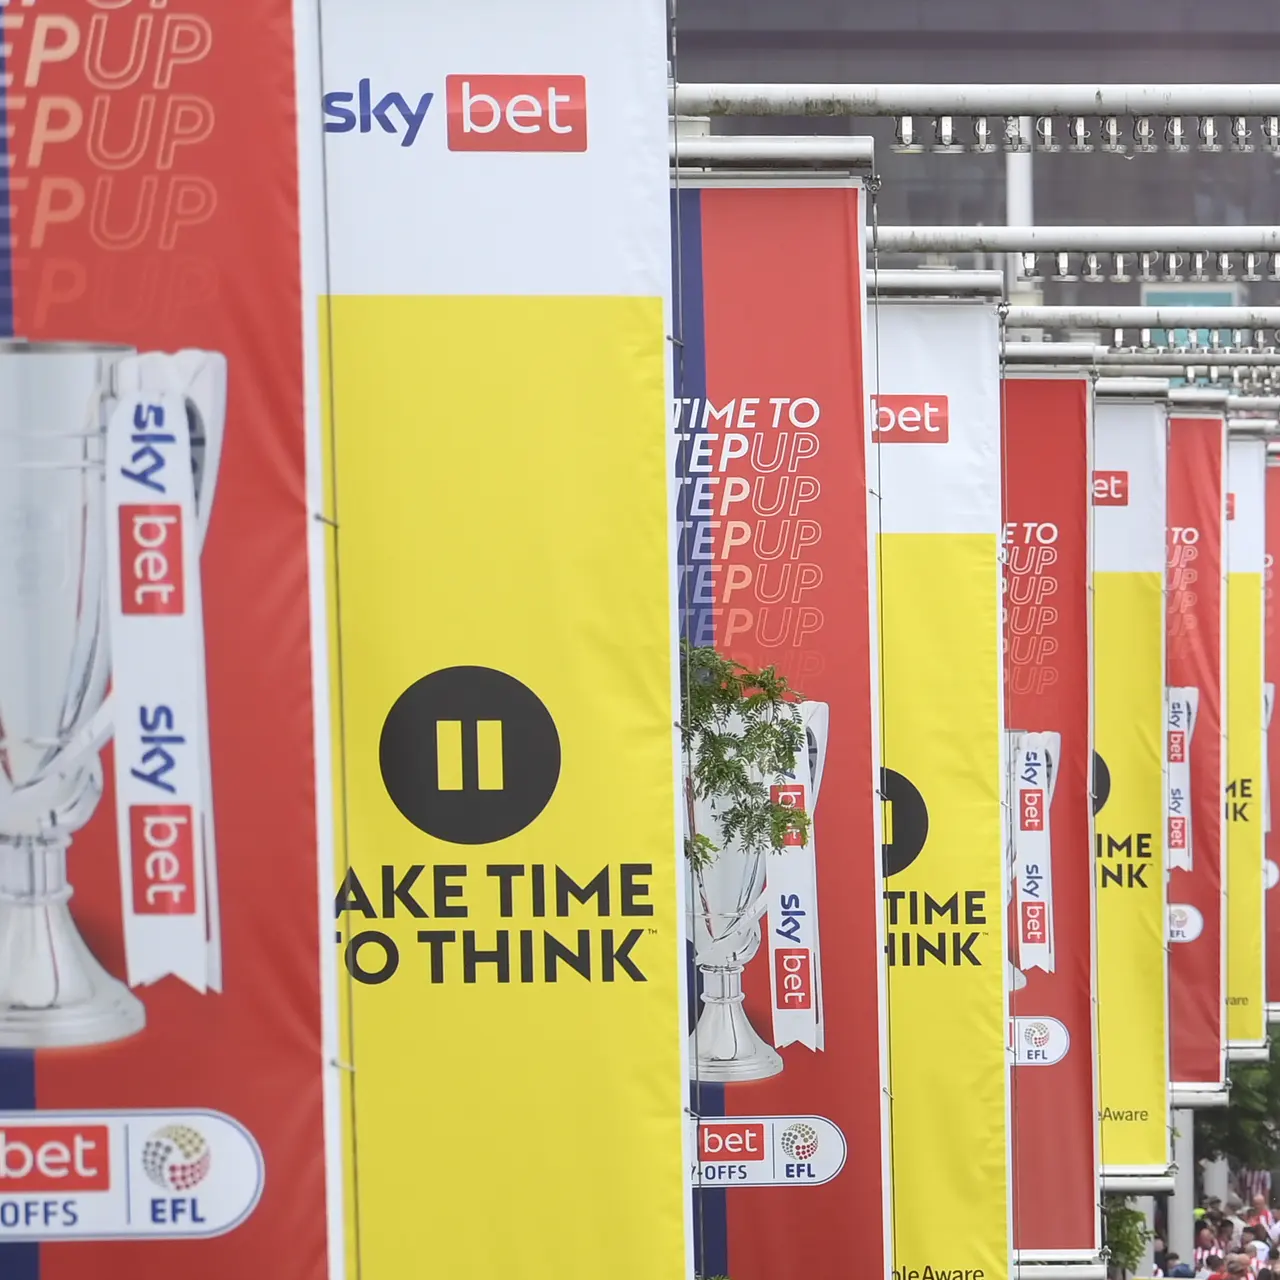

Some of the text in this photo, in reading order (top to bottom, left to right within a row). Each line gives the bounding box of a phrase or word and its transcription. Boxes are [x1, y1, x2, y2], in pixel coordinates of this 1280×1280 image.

[323, 78, 574, 148] sky bet
[768, 397, 821, 429] TO
[870, 398, 941, 432] bet
[120, 403, 178, 606] sky bet
[1022, 522, 1059, 544] TO
[1170, 527, 1200, 545] TO
[1169, 732, 1184, 761] bet
[131, 704, 188, 906] sky bet
[1020, 751, 1043, 828] sky bet
[1171, 818, 1184, 848] bet
[486, 863, 655, 918] TIME
[1022, 864, 1044, 940] sky bet
[882, 890, 987, 925] TIME
[775, 892, 806, 1004] sky bet
[1026, 1049, 1048, 1061] EFL
[0, 1130, 98, 1179] bet
[703, 1129, 758, 1153] bet
[785, 1162, 816, 1179] EFL
[0, 1199, 79, 1229] OFFS
[150, 1197, 207, 1224] EFL
